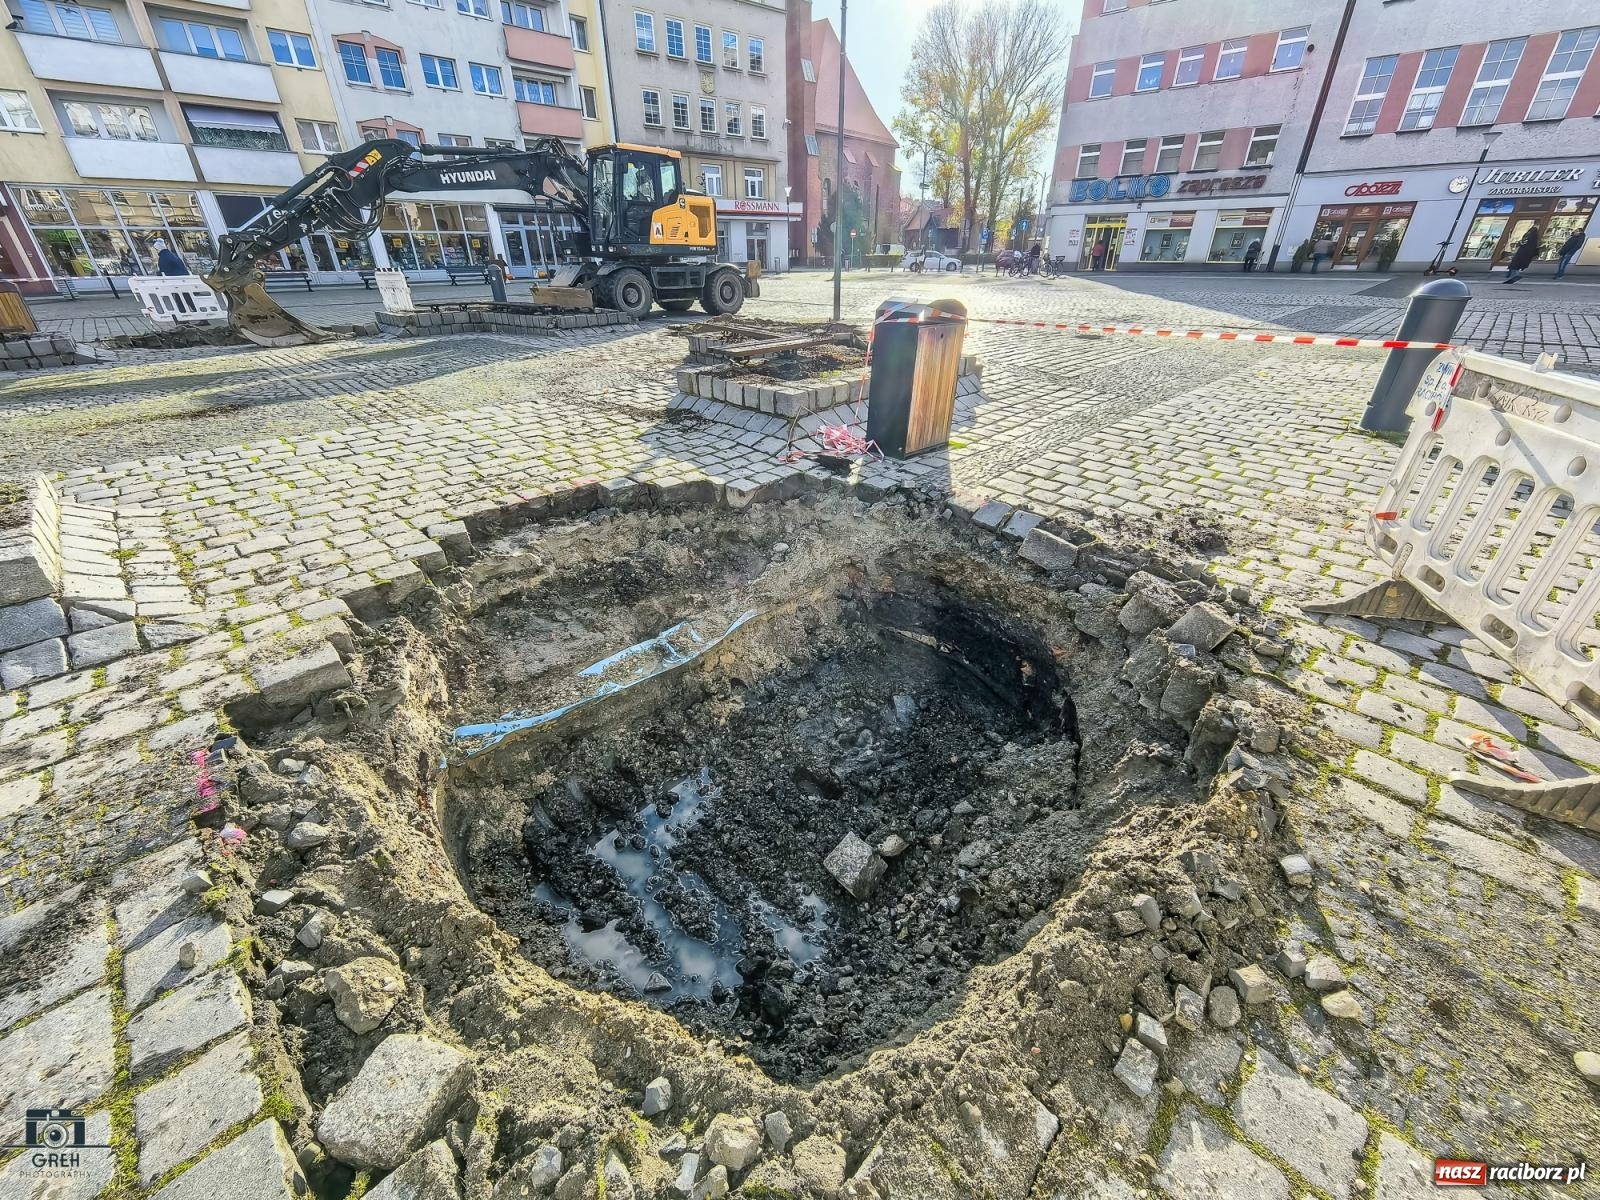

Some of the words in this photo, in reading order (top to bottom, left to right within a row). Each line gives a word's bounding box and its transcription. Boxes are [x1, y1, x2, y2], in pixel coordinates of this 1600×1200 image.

[440, 170, 497, 184] HYUNDAI
[1478, 168, 1584, 184] JUBILER
[1069, 174, 1170, 202] BOLKO
[1176, 175, 1267, 196] zaprasza
[1488, 186, 1562, 195] ZEGARMISTRZ
[735, 201, 779, 211] ROSSMANN
